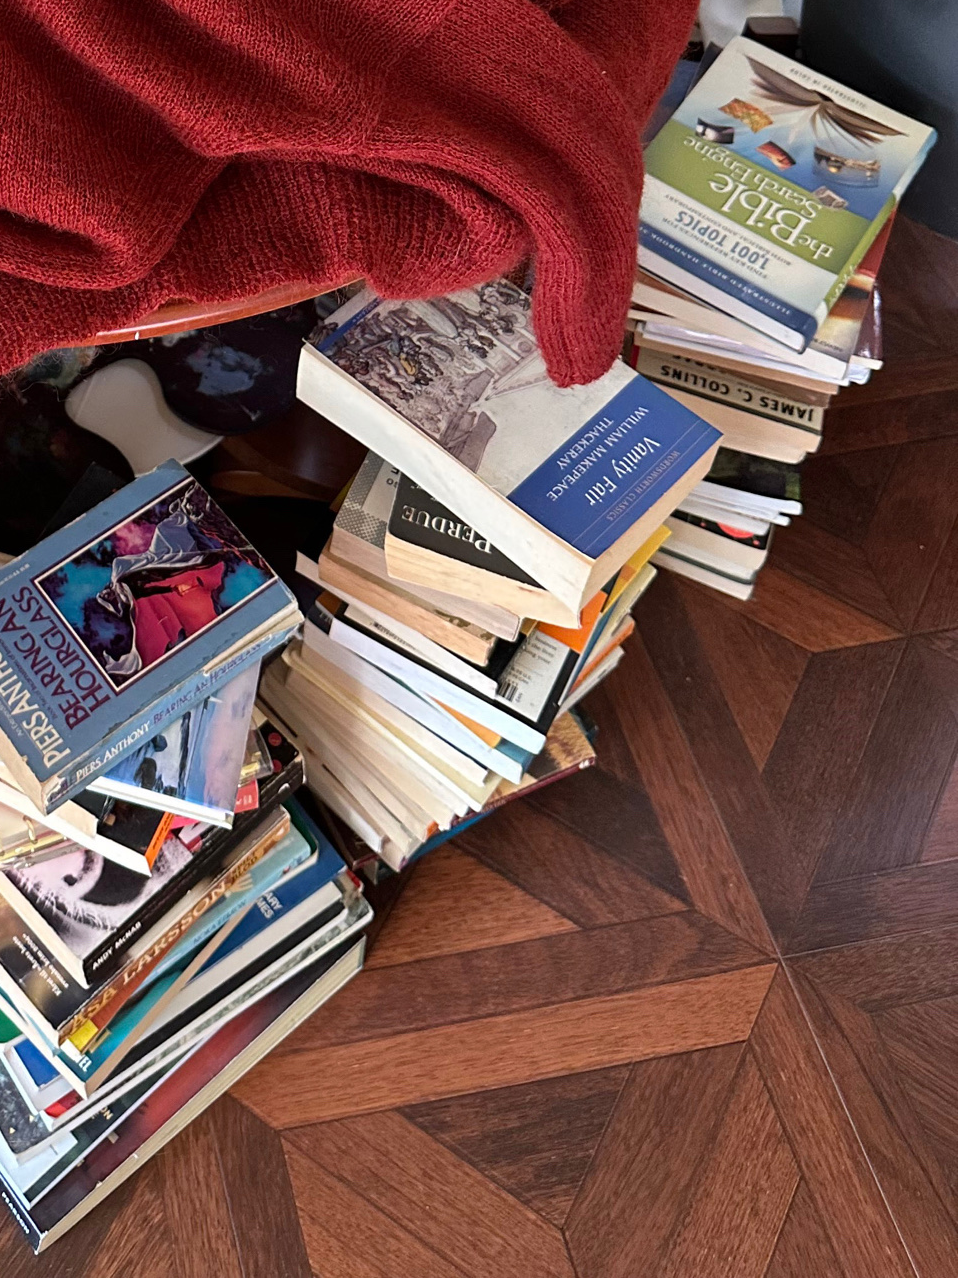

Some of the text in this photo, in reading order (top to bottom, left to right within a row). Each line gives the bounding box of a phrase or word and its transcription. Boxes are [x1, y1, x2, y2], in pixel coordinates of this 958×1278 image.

[682, 131, 822, 218] Search Engine
[673, 208, 772, 271] 1,001 TOPICS
[701, 169, 834, 263] the Bible
[660, 362, 730, 396] COLLINS
[736, 387, 753, 405] C.
[757, 393, 814, 423] JAMES
[546, 405, 650, 503] WILLIAM MAKEPEACE
[556, 416, 614, 472] THACKERAY
[587, 438, 661, 508] Vanity Fair
[606, 450, 680, 522] WORDSWORTH CLASSICS
[401, 505, 493, 554] PERDUE
[11, 587, 111, 711] HOURGLASS
[12, 633, 91, 729] BEARING
[21, 710, 71, 768] PIERS
[75, 643, 267, 782] PIERS ANTHONY BEARING AN HOURGLASS
[91, 921, 143, 971] ANDY McNAB
[122, 880, 227, 986] LARSSON
[0, 1190, 31, 1236] PEARSON
